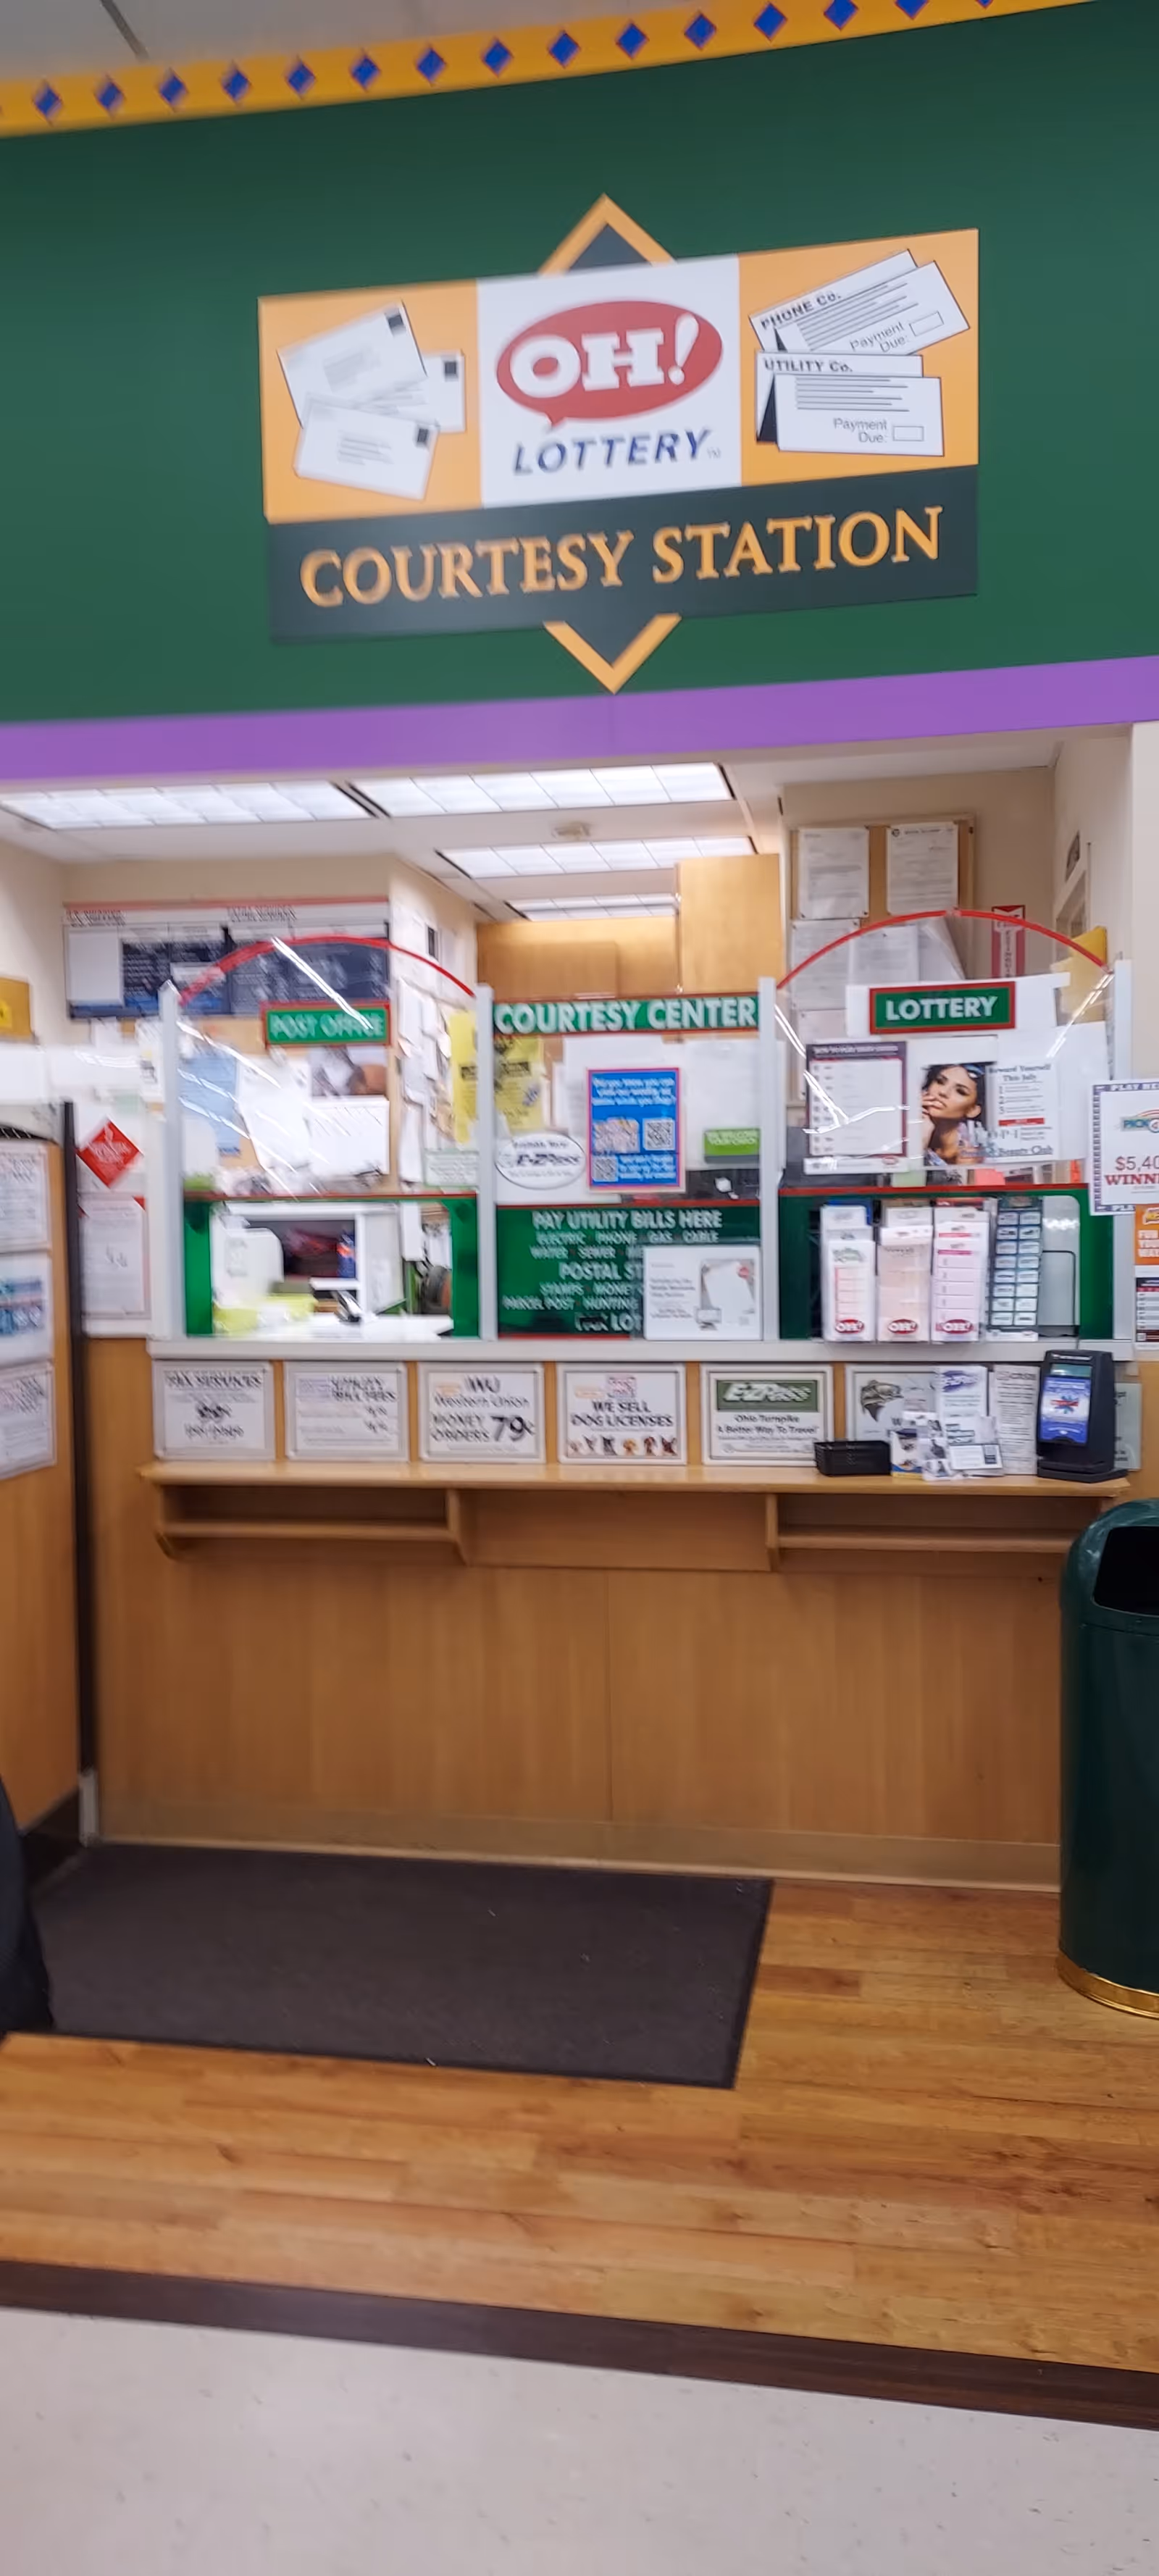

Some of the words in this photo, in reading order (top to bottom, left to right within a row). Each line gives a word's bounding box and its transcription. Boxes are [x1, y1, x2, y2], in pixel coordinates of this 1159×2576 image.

[760, 298, 813, 330] PHONE
[816, 291, 842, 311] Co.
[850, 323, 904, 352] Payment
[879, 335, 910, 354] Due:
[510, 312, 700, 398] OH!
[764, 359, 824, 373] UTILITY
[829, 360, 853, 373] Co.
[833, 418, 887, 431] Payment
[858, 431, 887, 444] Due:
[513, 428, 713, 477] LOTTERY
[301, 531, 635, 608] COURTESY
[653, 506, 943, 583] STATION
[495, 1001, 639, 1034] COURTESY
[647, 998, 756, 1029] CENTER
[885, 996, 998, 1021] LOTTERY
[270, 1013, 319, 1039] POST
[321, 1011, 386, 1039] OFFICE
[1105, 1173, 1159, 1186] WINN
[532, 1210, 565, 1230] PAY
[566, 1210, 629, 1229] UTILITY
[631, 1210, 677, 1229] BILLS
[679, 1210, 723, 1229] HERE
[558, 1262, 622, 1281] POSTAL
[617, 1399, 652, 1413] SELL
